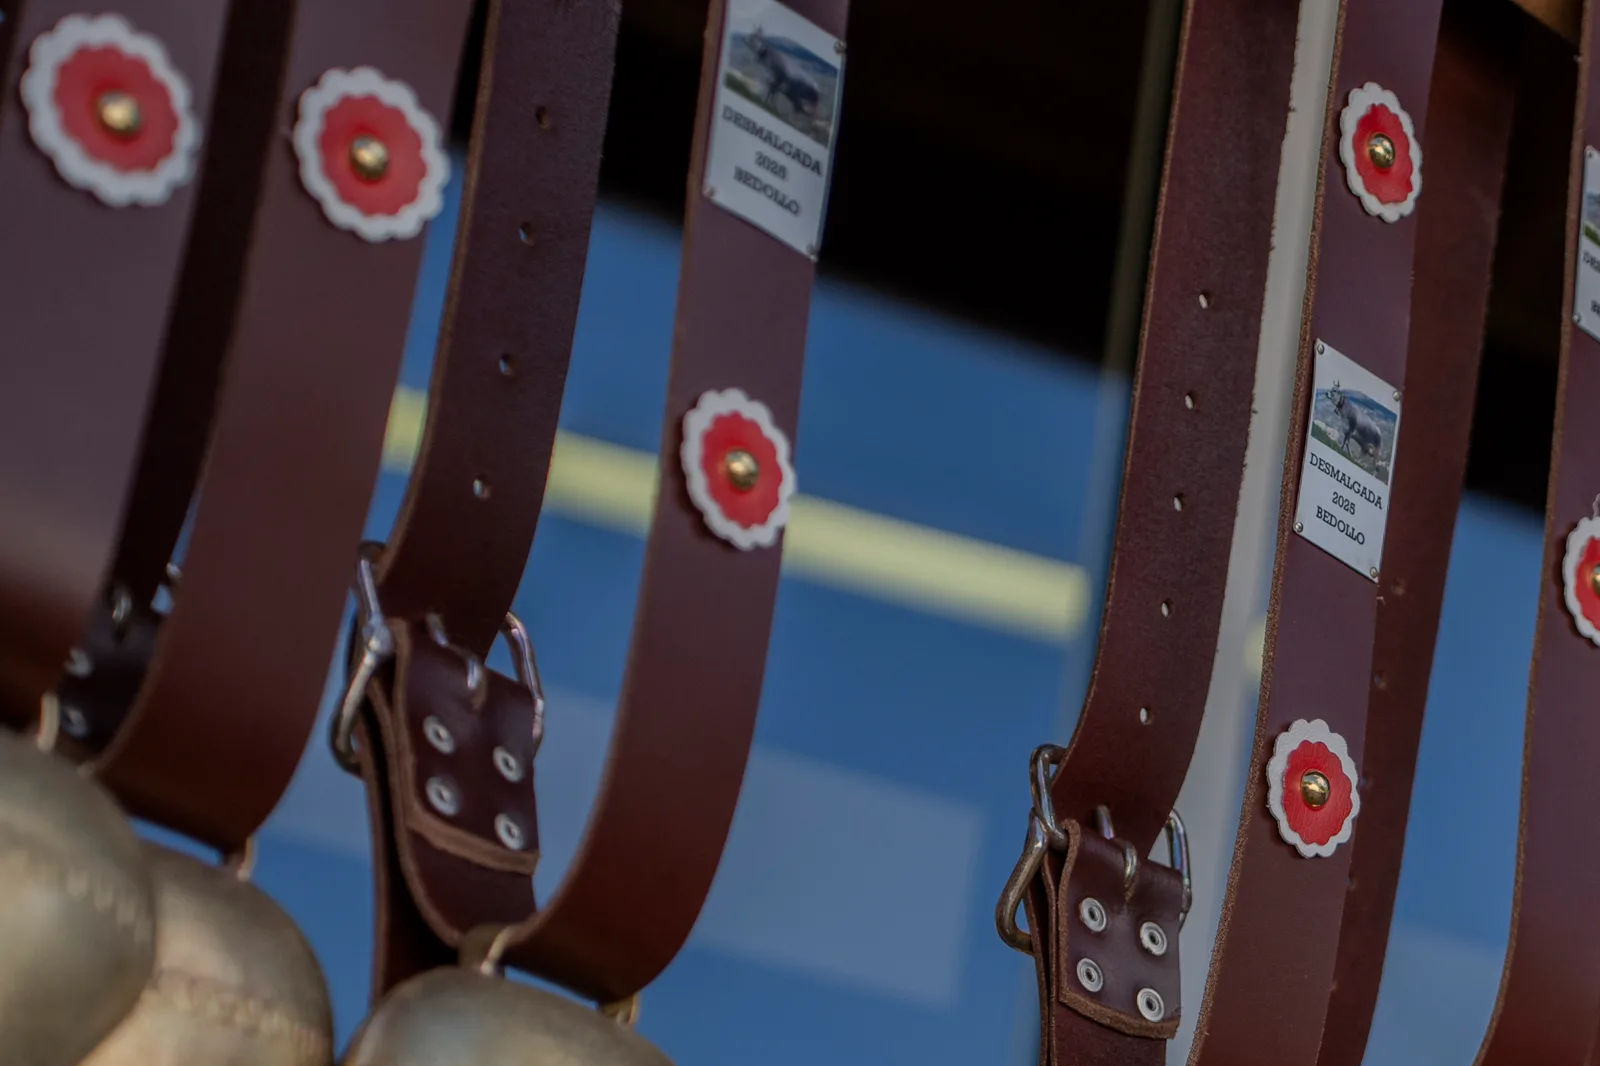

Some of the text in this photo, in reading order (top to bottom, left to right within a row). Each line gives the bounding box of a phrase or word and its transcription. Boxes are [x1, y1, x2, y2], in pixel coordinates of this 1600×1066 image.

[722, 104, 822, 176] DESMALGADA
[734, 165, 801, 216] BEDOLLO
[1309, 452, 1383, 510] DESMALGADA
[1332, 491, 1356, 515] 2025
[1316, 505, 1366, 545] BEDOLLO
